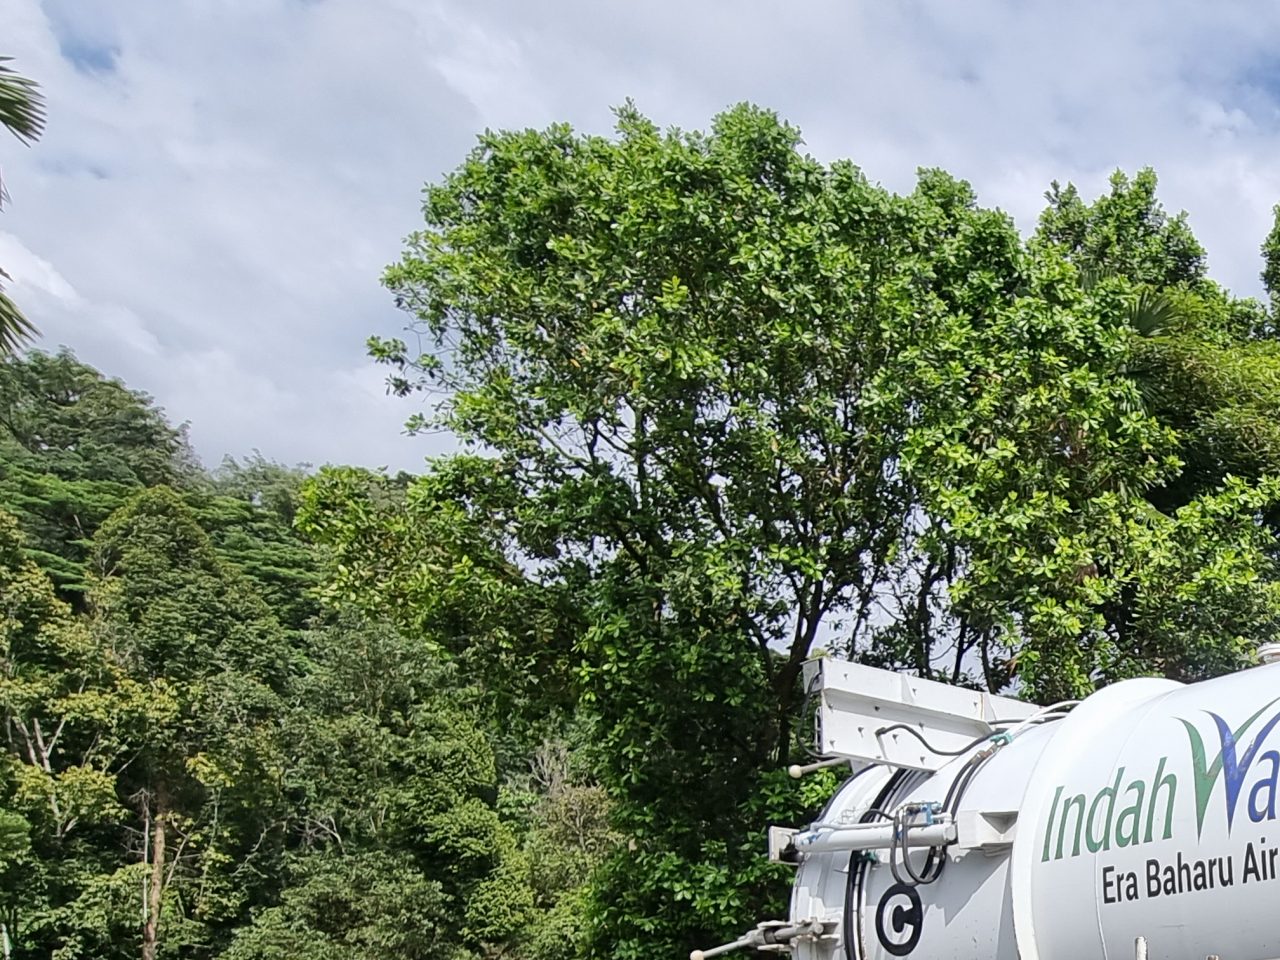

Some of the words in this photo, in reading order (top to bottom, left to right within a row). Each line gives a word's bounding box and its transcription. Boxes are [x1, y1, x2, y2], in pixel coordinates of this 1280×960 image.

[1102, 865, 1139, 904] Era
[1146, 852, 1234, 897] Baharu
[1243, 837, 1279, 884] Air
[882, 893, 915, 945] C
